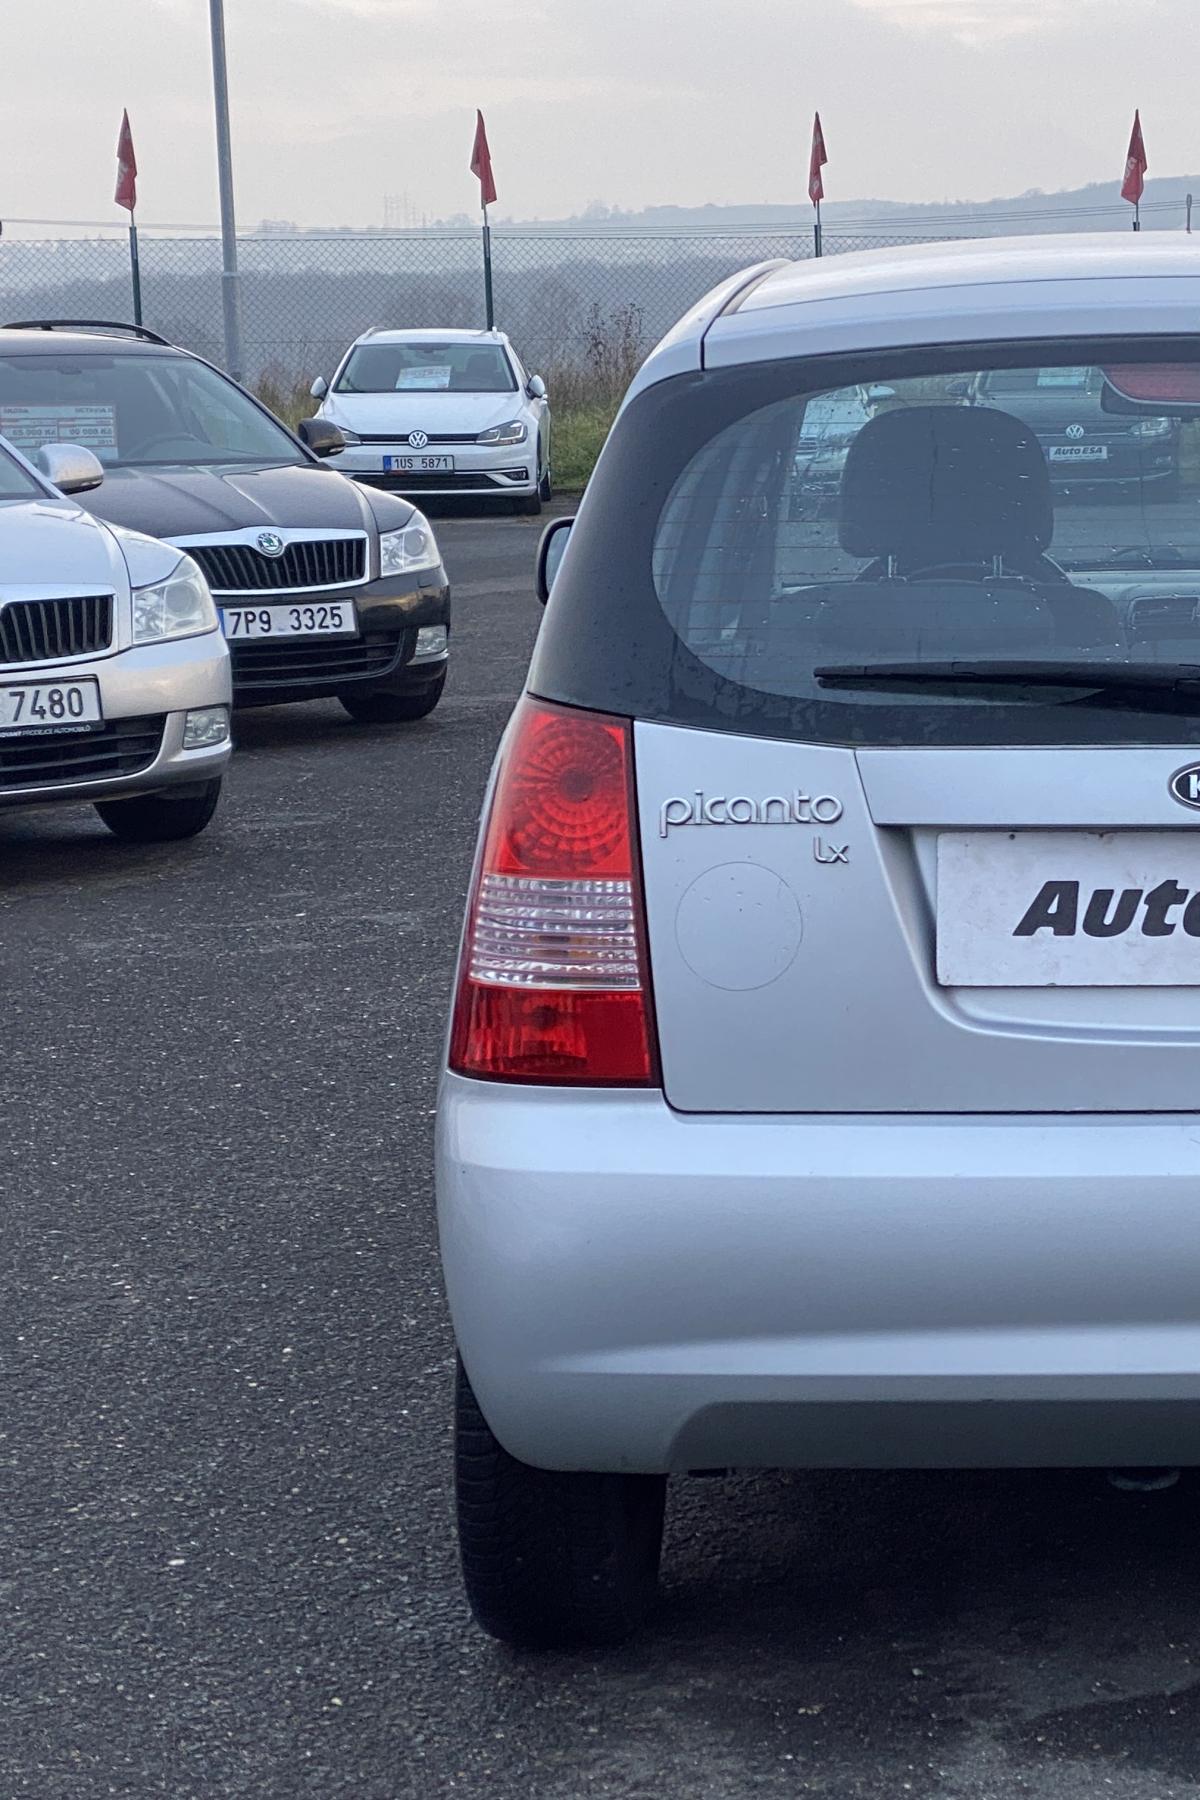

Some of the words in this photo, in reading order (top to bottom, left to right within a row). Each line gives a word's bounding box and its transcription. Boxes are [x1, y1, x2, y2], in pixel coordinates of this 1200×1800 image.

[394, 458, 413, 469] 1US
[421, 457, 448, 469] 5871
[1054, 447, 1080, 456] Auto
[1082, 446, 1103, 454] ESA
[229, 610, 271, 635] 7P9
[289, 606, 343, 631] 3325
[9, 687, 84, 722] 7480
[659, 789, 844, 838] picanto
